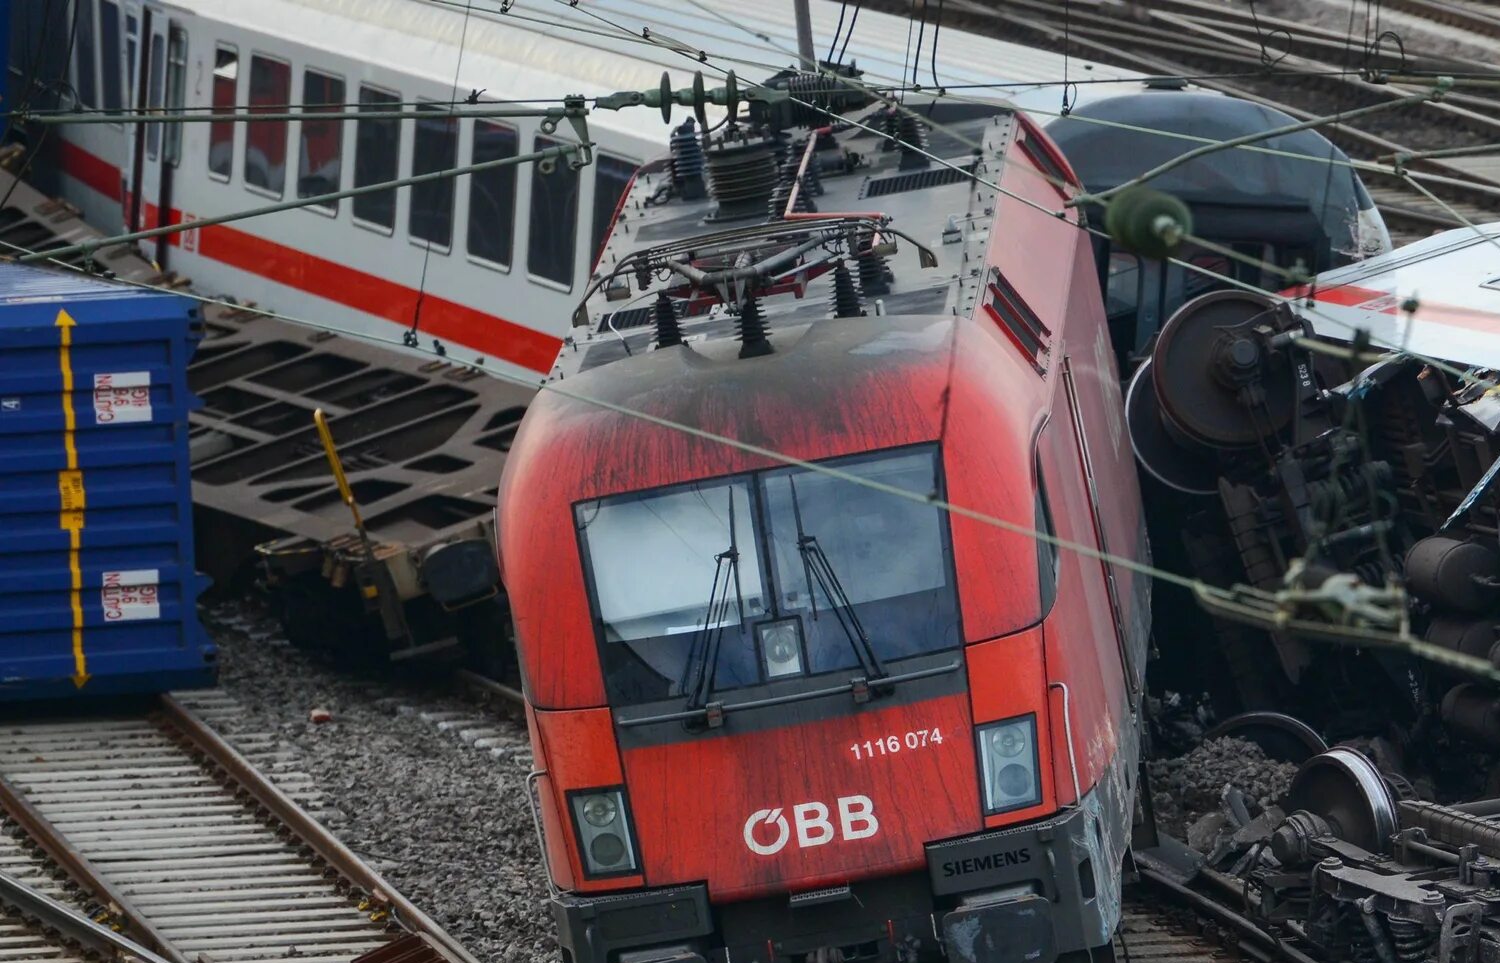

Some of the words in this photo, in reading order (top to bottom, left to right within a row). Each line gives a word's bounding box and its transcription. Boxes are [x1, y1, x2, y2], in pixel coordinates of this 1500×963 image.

[95, 375, 114, 422] CAUTON
[103, 573, 122, 620] CAUTON
[851, 735, 901, 760] 1116
[904, 728, 944, 750] 074
[743, 795, 879, 856] ÖBB
[943, 848, 1031, 878] SIEMENS
